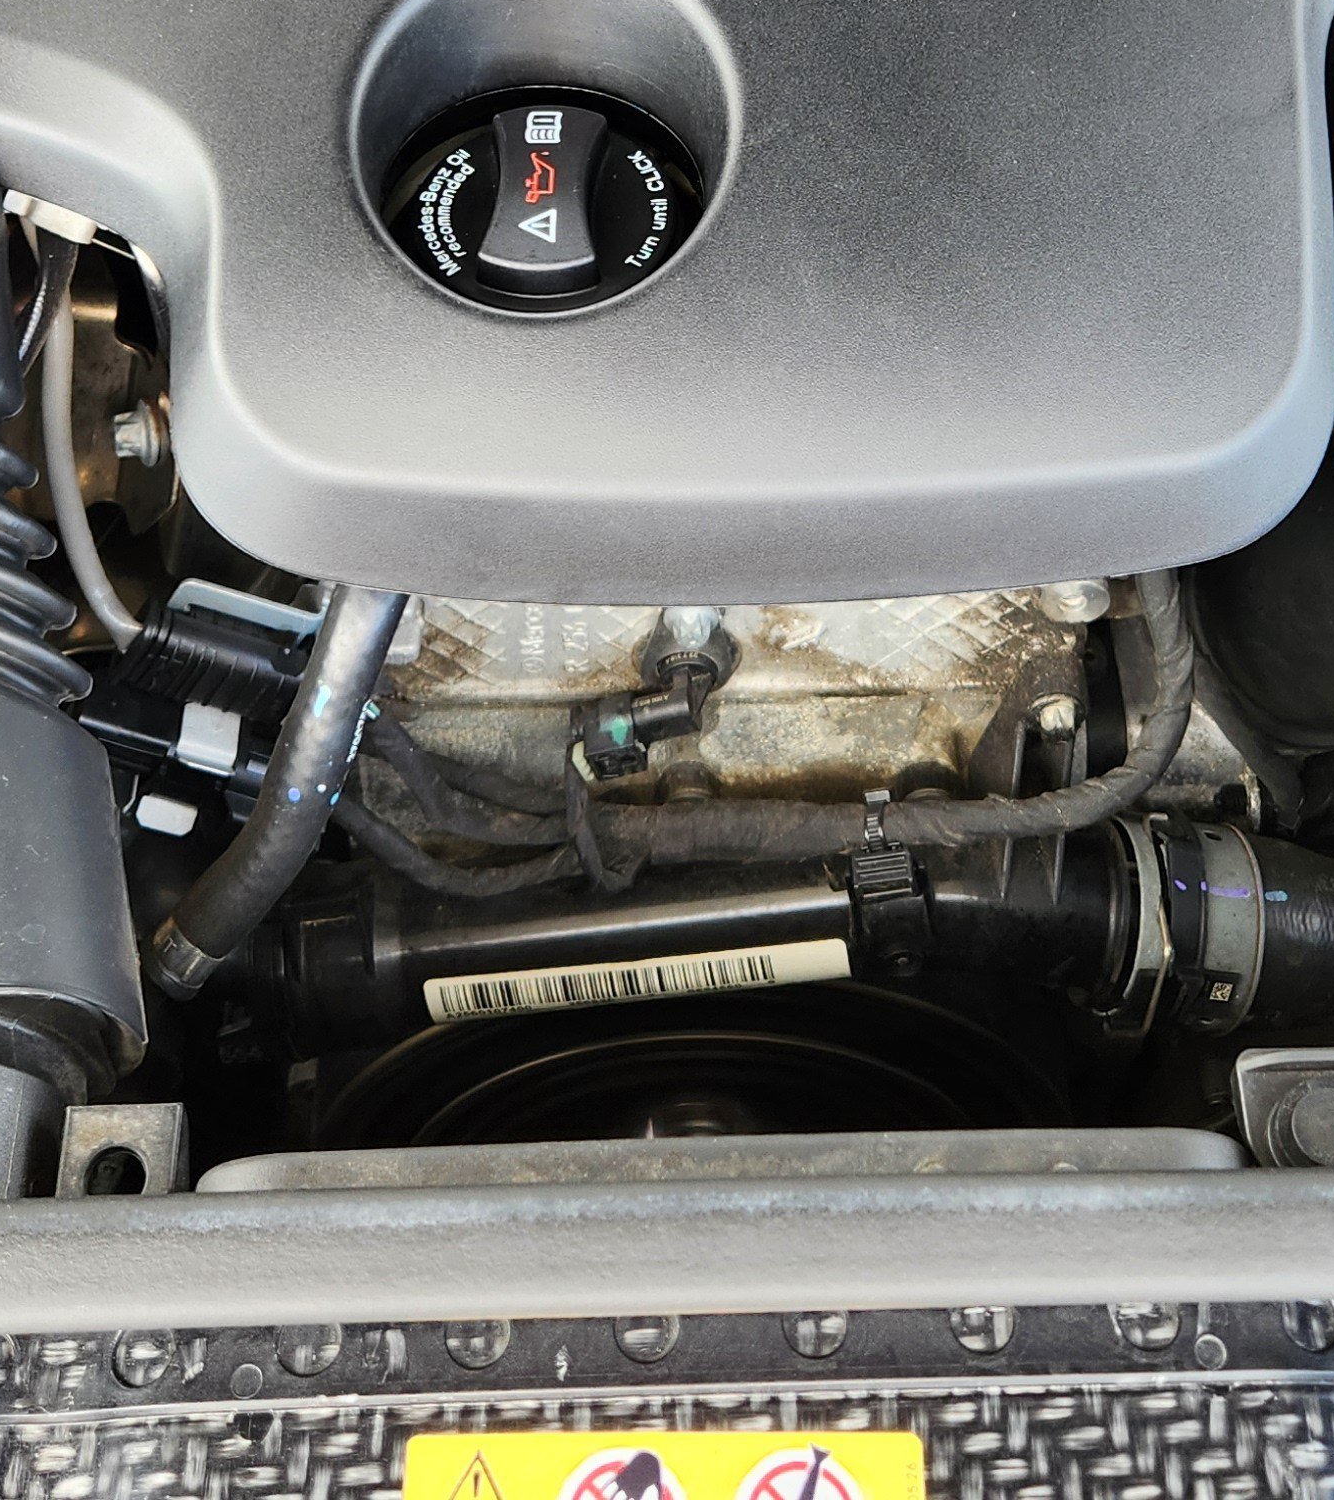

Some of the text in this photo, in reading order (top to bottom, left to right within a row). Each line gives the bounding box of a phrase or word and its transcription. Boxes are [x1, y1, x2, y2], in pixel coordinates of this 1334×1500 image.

[417, 148, 472, 277] Mercedes-Benz Oil
[436, 165, 475, 258] recommended
[625, 150, 668, 269] Turn until CLICK
